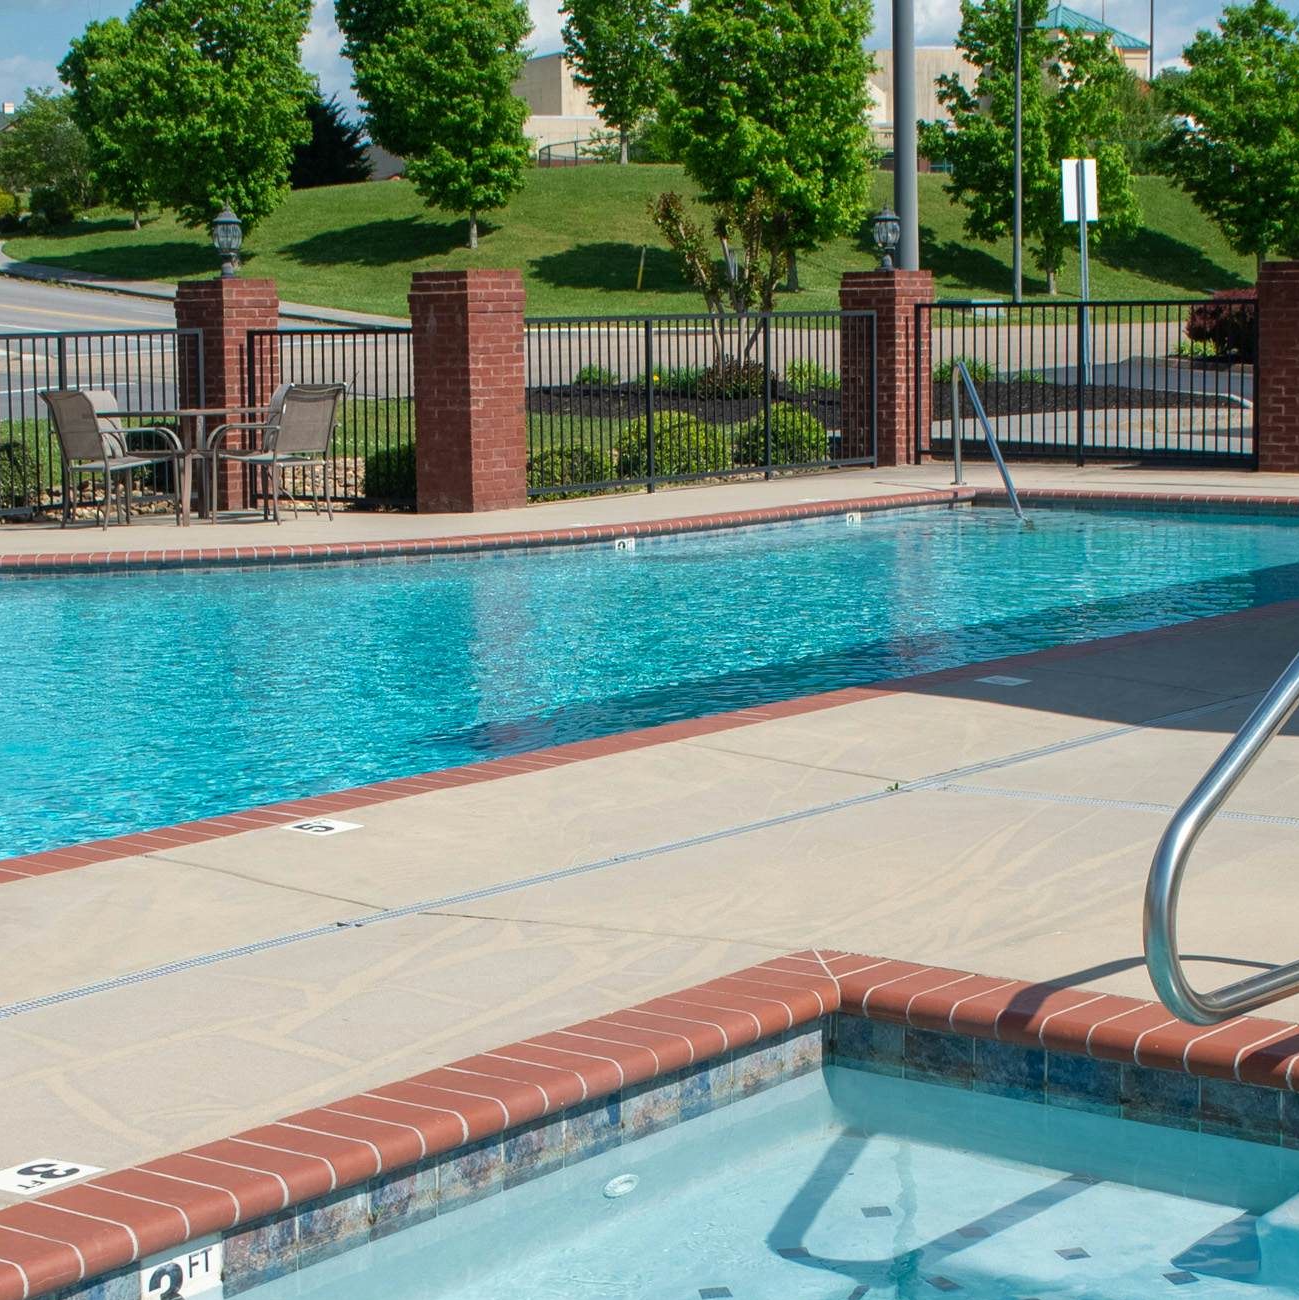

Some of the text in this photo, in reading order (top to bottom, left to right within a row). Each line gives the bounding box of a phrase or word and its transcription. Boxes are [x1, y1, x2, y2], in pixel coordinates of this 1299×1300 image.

[292, 823, 334, 832] 5
[17, 1163, 80, 1190] 3 FT
[188, 1247, 213, 1279] FT
